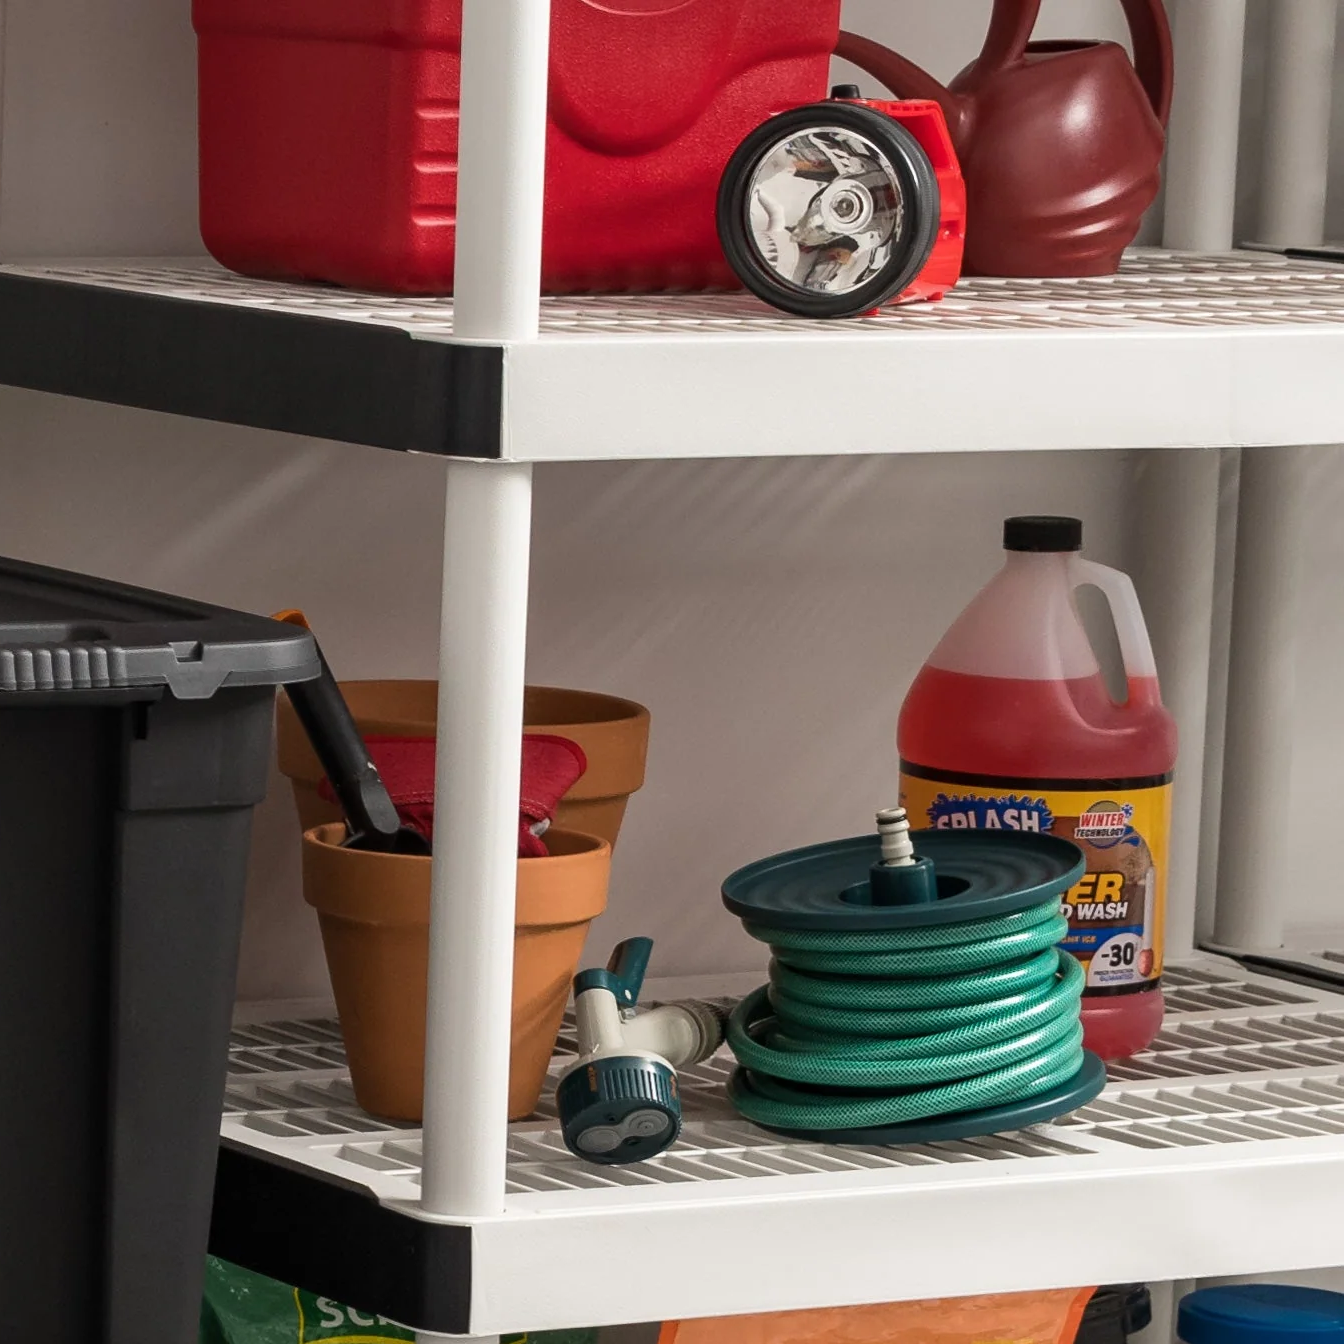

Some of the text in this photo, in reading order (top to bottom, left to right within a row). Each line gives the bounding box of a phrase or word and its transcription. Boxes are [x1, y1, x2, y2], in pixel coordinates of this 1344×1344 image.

[1081, 813, 1125, 826] WINTER
[1076, 828, 1124, 838] TECHNOLOGY
[1077, 902, 1128, 920] WASH
